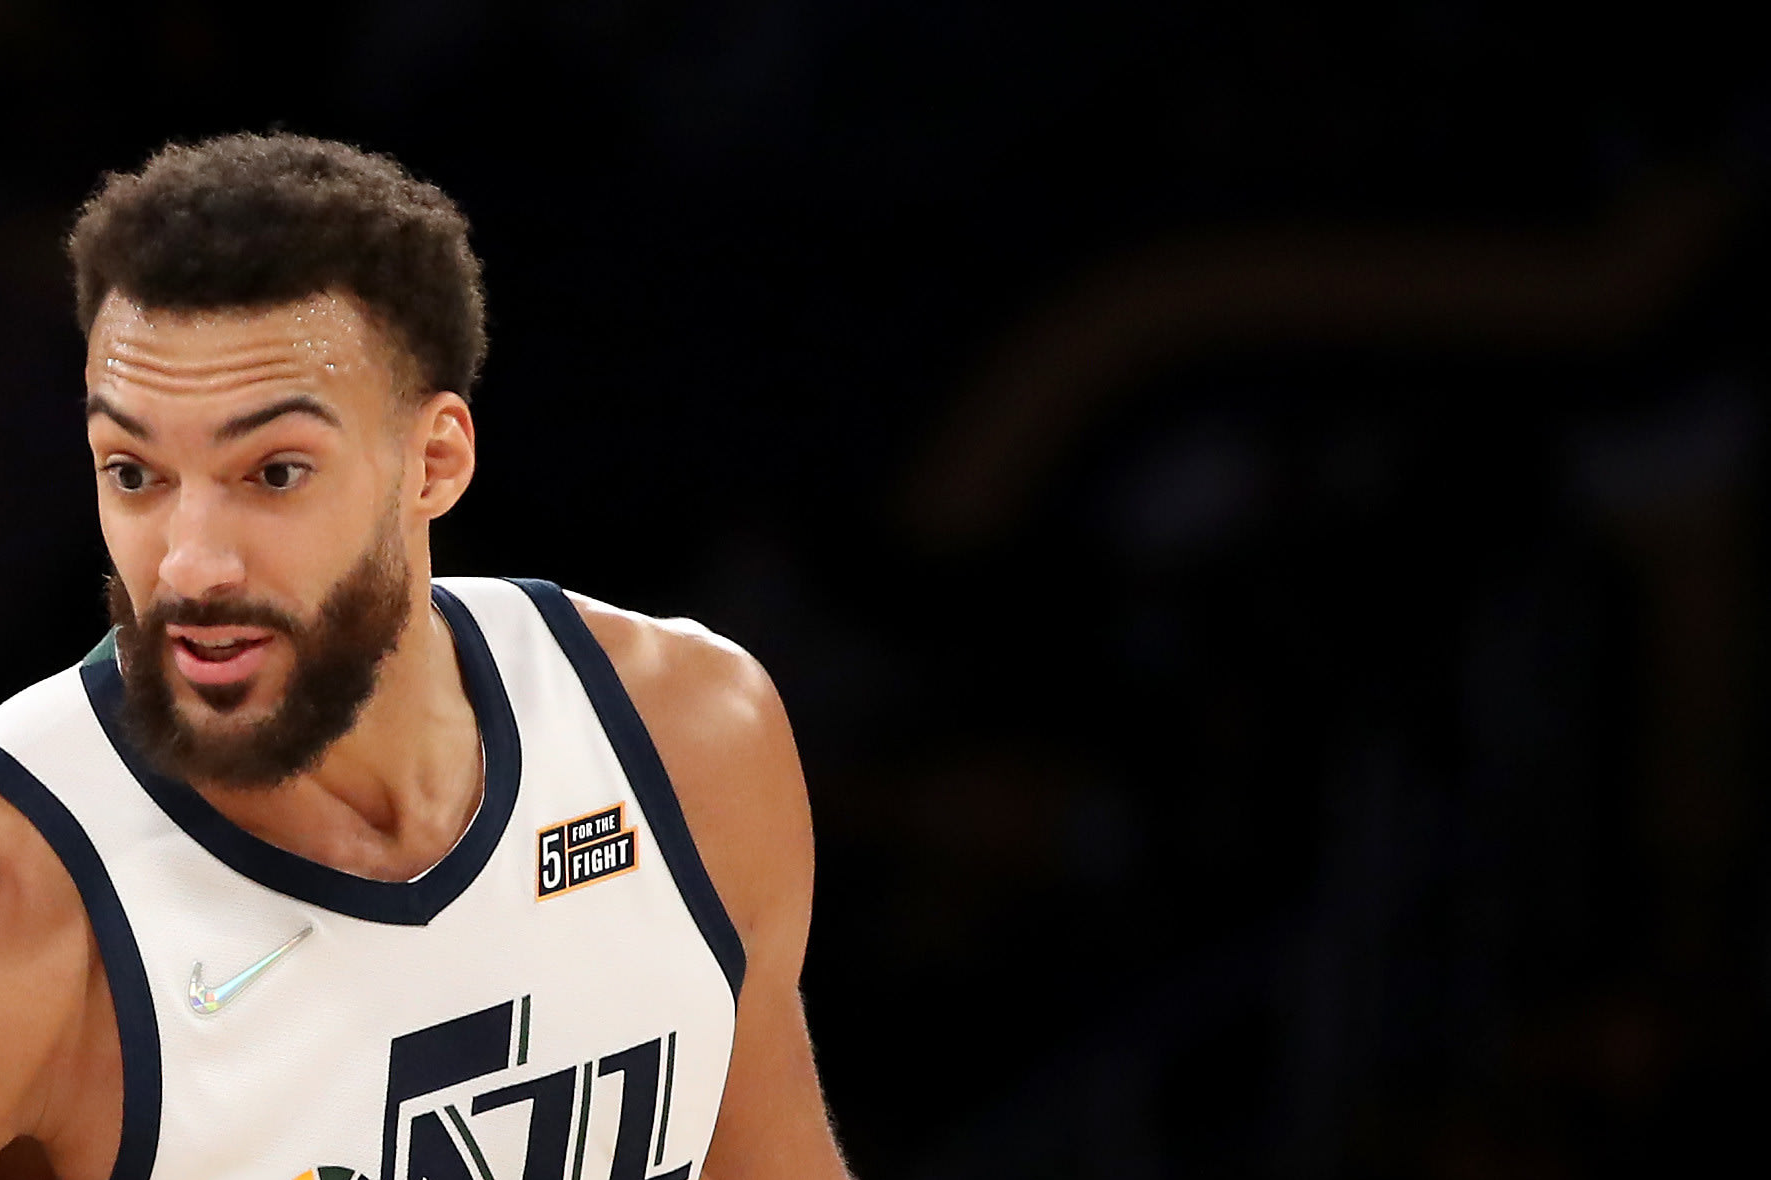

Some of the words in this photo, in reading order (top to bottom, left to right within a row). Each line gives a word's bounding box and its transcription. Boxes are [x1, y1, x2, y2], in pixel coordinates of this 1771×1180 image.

[572, 822, 593, 842] FOR
[595, 814, 616, 834] THE
[542, 832, 561, 889] 5
[572, 838, 629, 881] FIGHT
